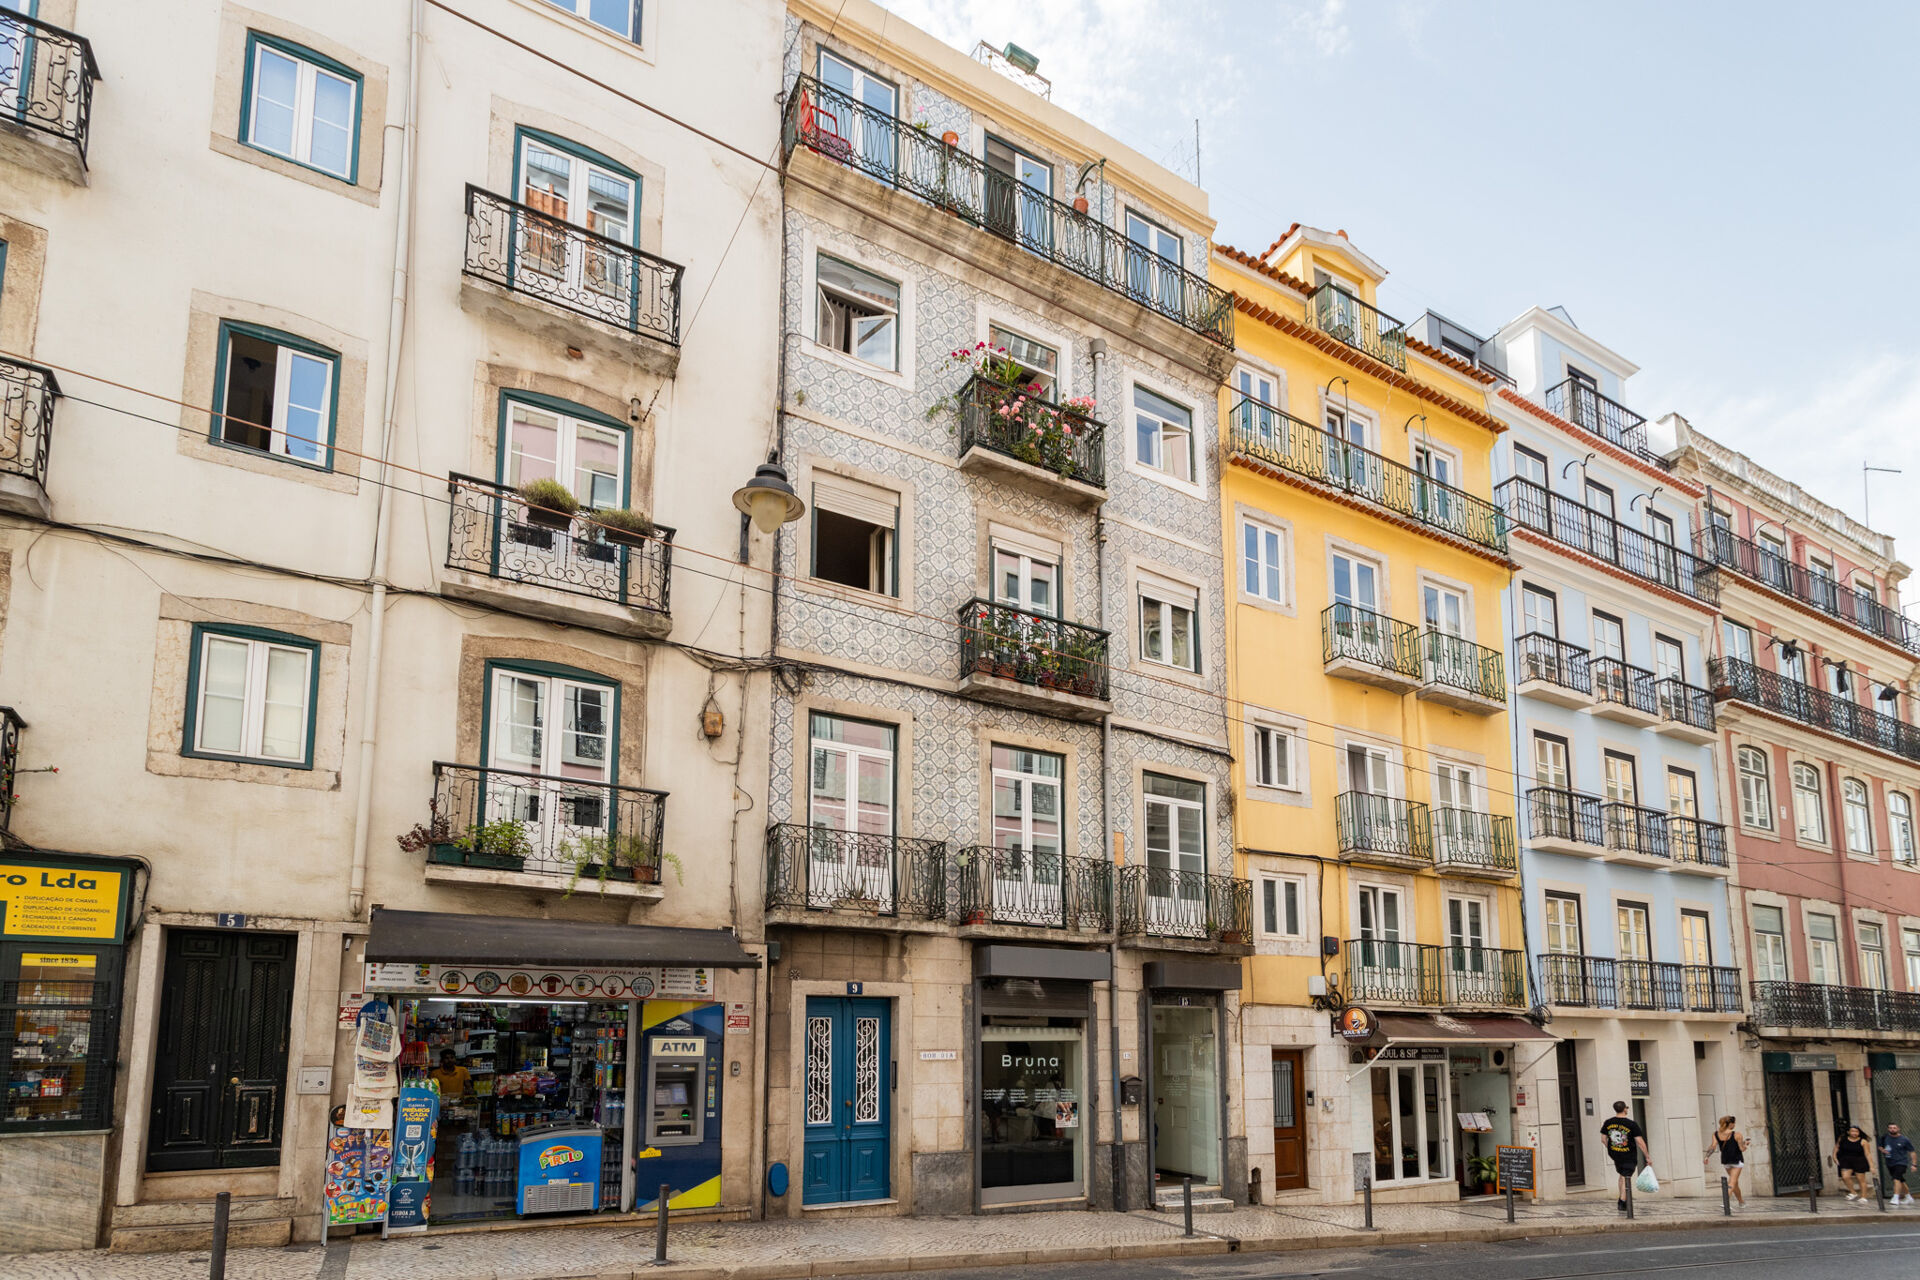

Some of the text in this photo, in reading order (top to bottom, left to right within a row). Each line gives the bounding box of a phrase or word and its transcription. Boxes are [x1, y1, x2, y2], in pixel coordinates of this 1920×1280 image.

[40, 872, 97, 890] Lda
[227, 914, 236, 927] 5
[852, 983, 858, 993] 9
[661, 1042, 697, 1052] ATM
[1400, 1049, 1405, 1058] &
[1002, 1054, 1059, 1067] Bruna
